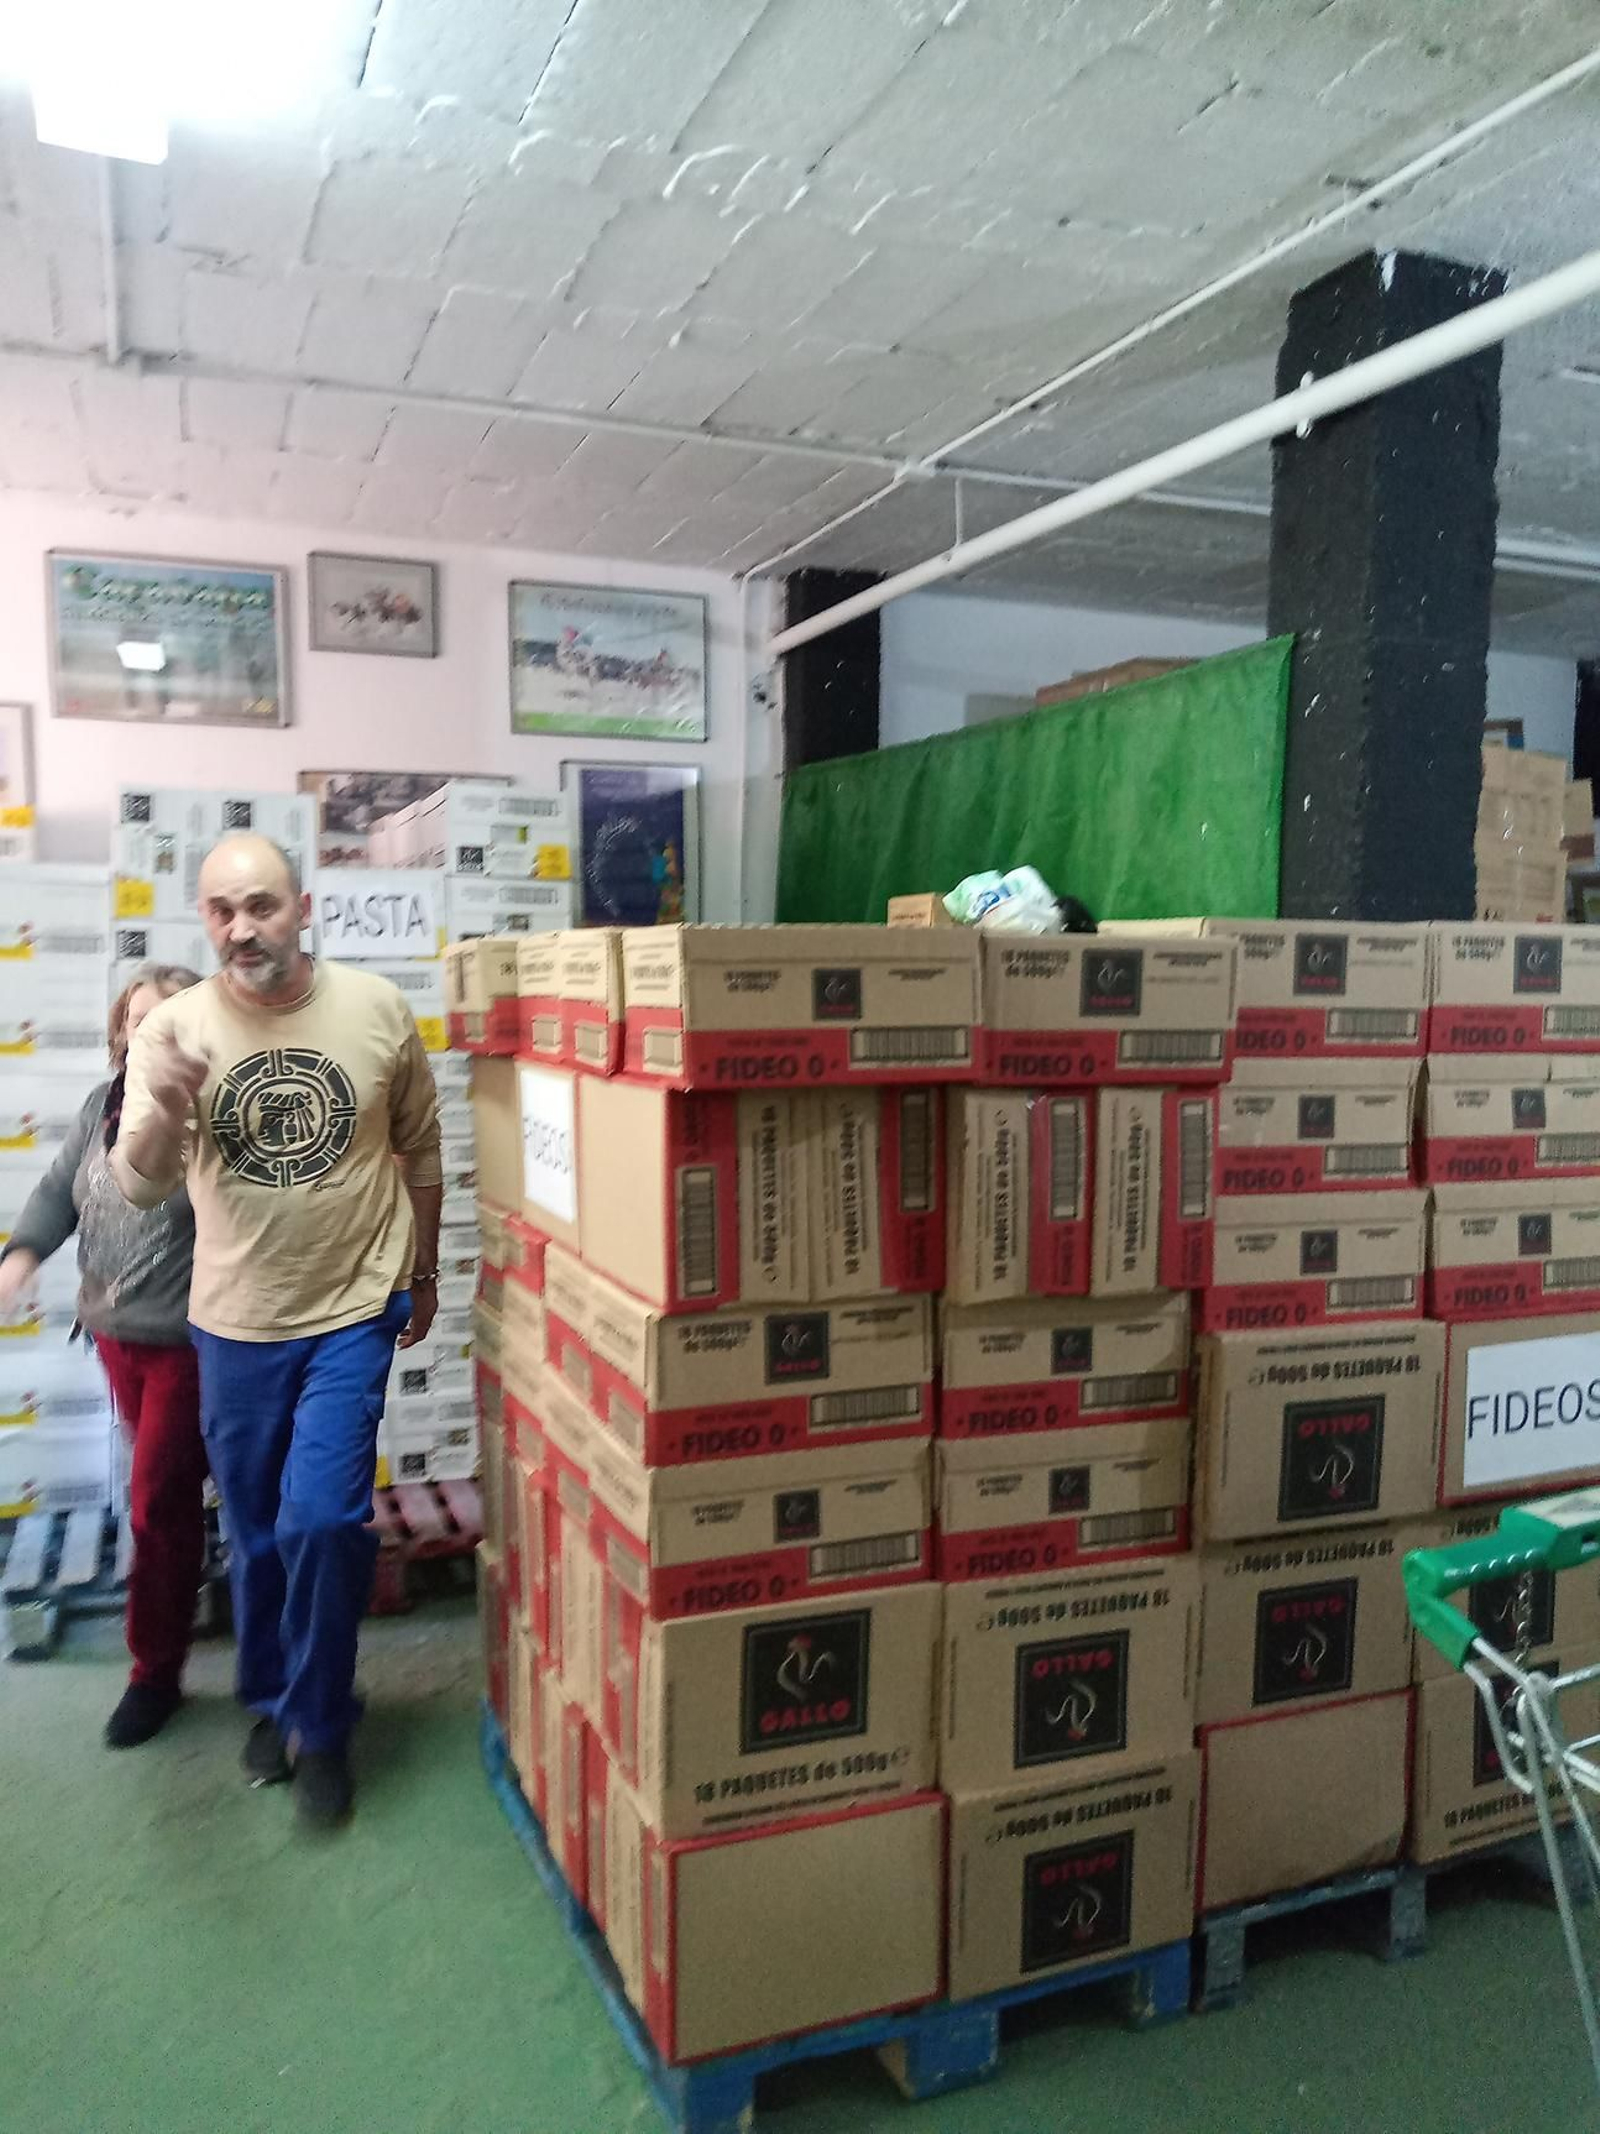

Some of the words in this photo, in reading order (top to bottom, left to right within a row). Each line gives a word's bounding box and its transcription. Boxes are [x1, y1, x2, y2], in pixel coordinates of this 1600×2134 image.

[321, 891, 428, 939] PASTA
[1235, 1029, 1287, 1051] IDEO
[1450, 1026, 1508, 1047] FIDEO
[715, 1057, 799, 1080] FIDEO
[998, 1055, 1071, 1077] FIDEO
[1223, 1167, 1286, 1189] FIDEO
[1447, 1156, 1503, 1177] FIDEO
[1453, 1287, 1510, 1308] FIDEO
[1226, 1303, 1289, 1329] FIDEO
[1311, 1362, 1332, 1382] de
[1333, 1356, 1404, 1380] PAQUETES
[968, 1406, 1038, 1432] FIDEO
[1467, 1377, 1600, 1441] FIDEOS
[1297, 1412, 1372, 1439] GALLO
[682, 1426, 761, 1457] FIDEO
[967, 1547, 1036, 1576] FIDEO
[1285, 1549, 1304, 1567] de
[1306, 1540, 1376, 1565] PAQUETES
[681, 1580, 761, 1613] FIDEO
[1072, 1590, 1149, 1619] PAQUETES
[1269, 1594, 1346, 1624] GALLO
[1046, 1600, 1068, 1623] de
[1032, 1648, 1115, 1678] GALLO
[759, 1698, 852, 1735] GALLO
[720, 1763, 809, 1799] PAQUETES
[813, 1760, 836, 1783] de
[1053, 1809, 1074, 1831] de
[1076, 1791, 1153, 1827] PAQUETES
[1040, 1852, 1120, 1886] GALLO
